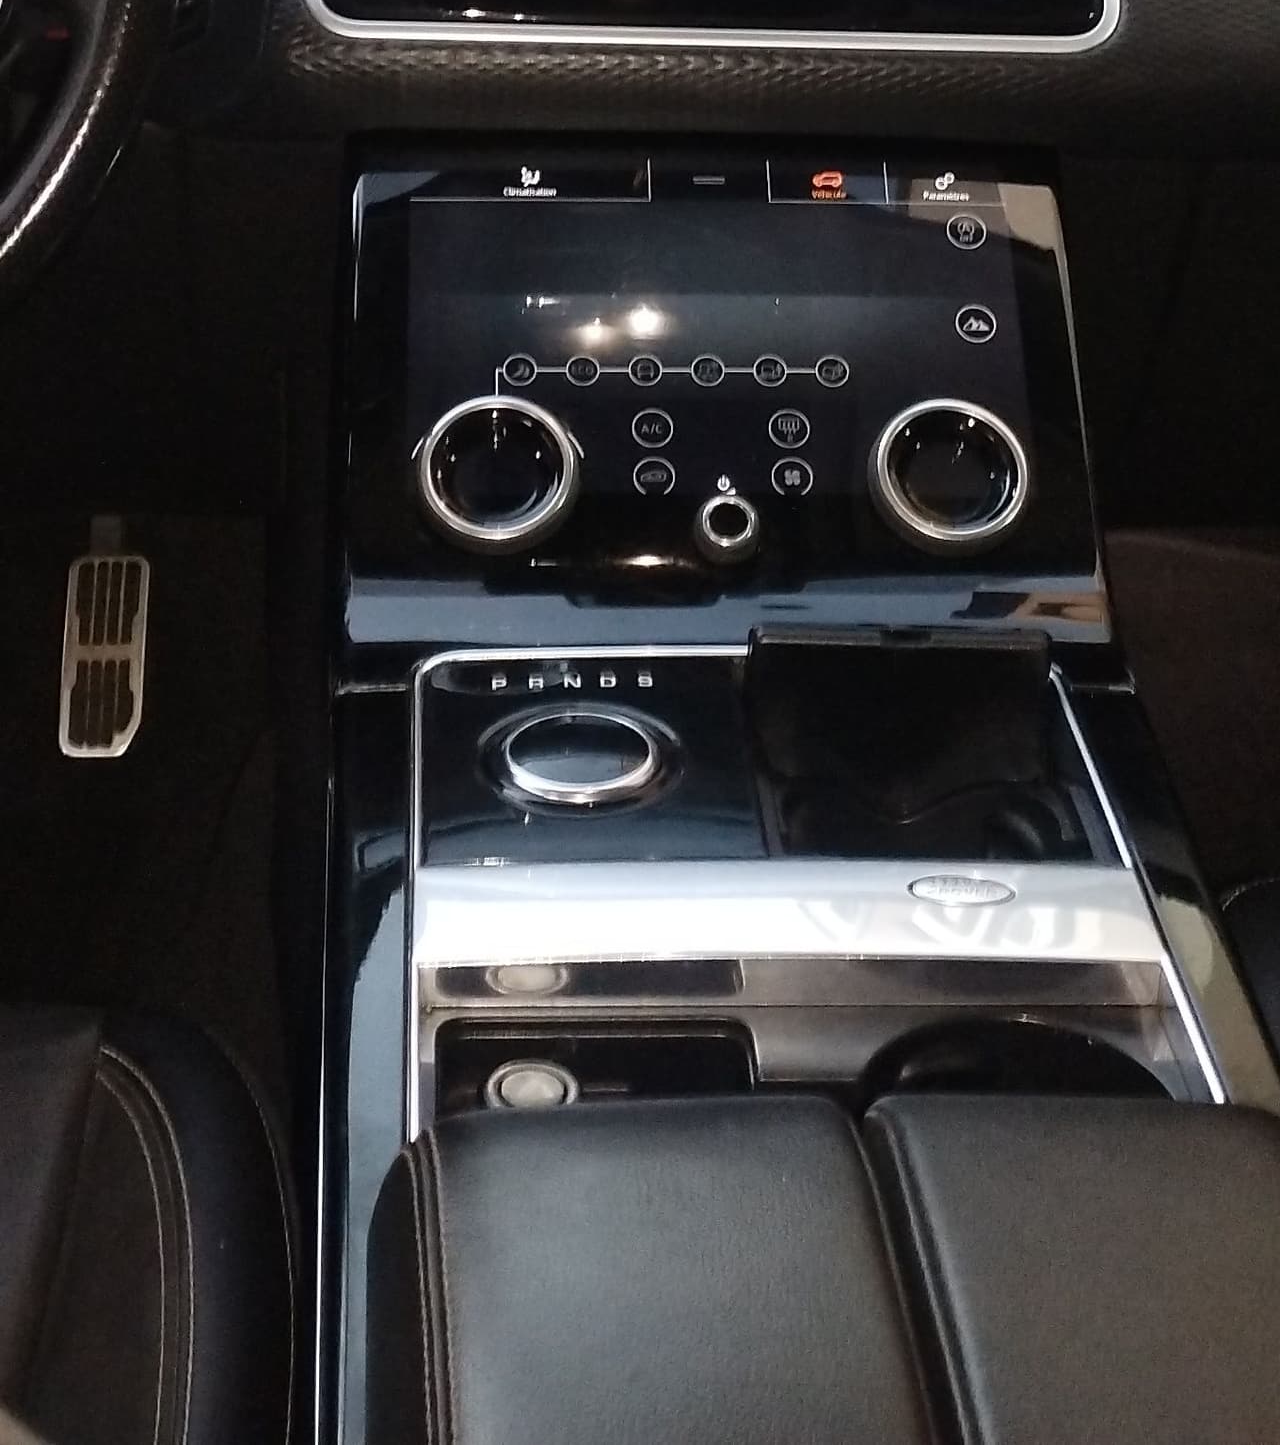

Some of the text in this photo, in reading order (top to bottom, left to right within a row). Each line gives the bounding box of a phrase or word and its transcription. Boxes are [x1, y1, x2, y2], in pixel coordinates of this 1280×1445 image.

[640, 423, 664, 435] A/C
[491, 675, 508, 691] P
[564, 673, 582, 688] N
[600, 672, 617, 688] D
